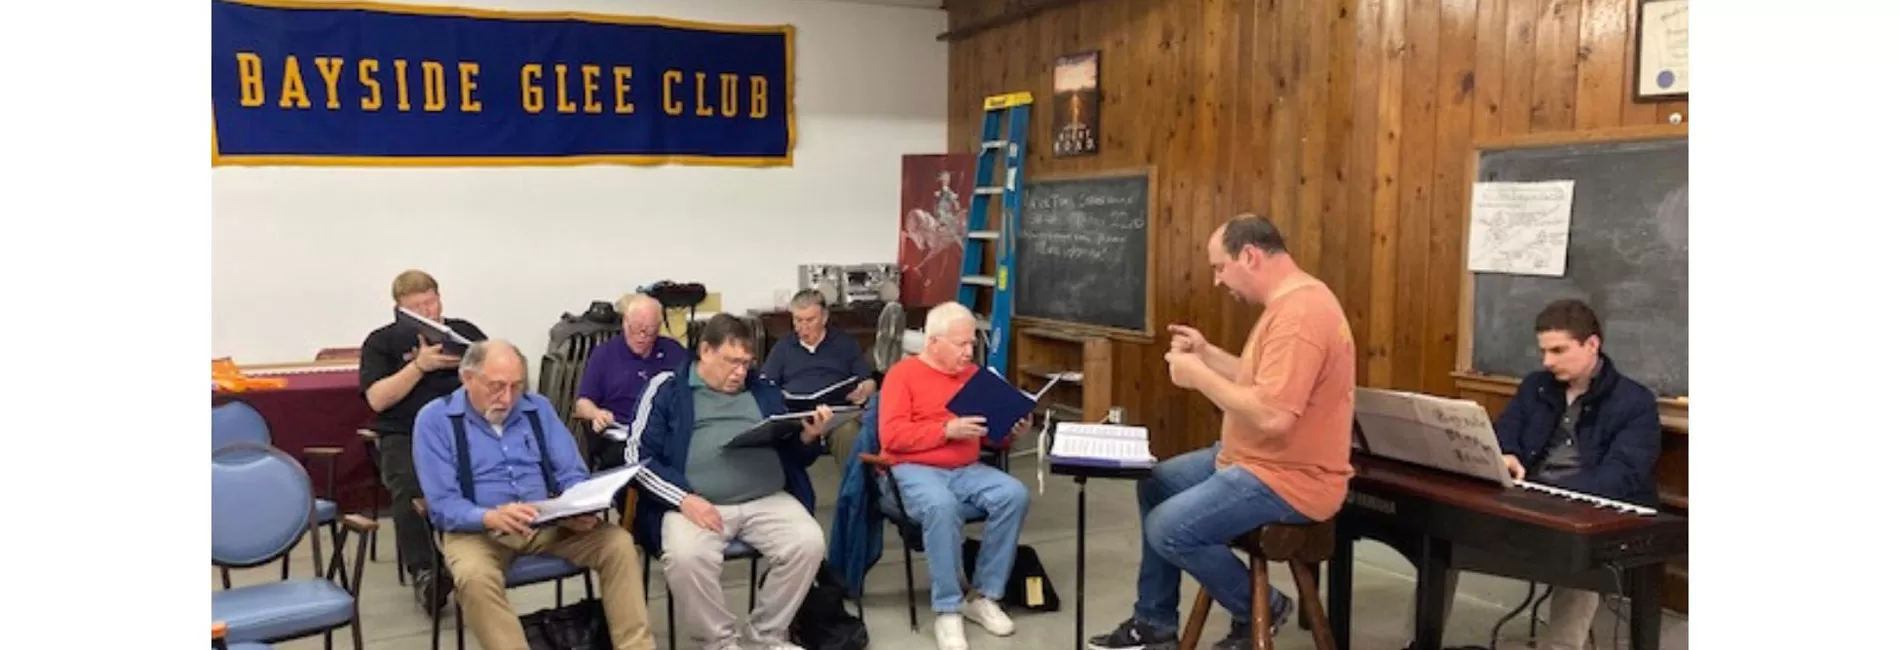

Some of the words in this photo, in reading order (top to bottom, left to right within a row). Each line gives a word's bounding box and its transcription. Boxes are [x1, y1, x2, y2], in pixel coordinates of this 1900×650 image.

[237, 52, 483, 113] BAYSIDE
[519, 62, 635, 115] GLEE
[661, 69, 769, 119] CLUB
